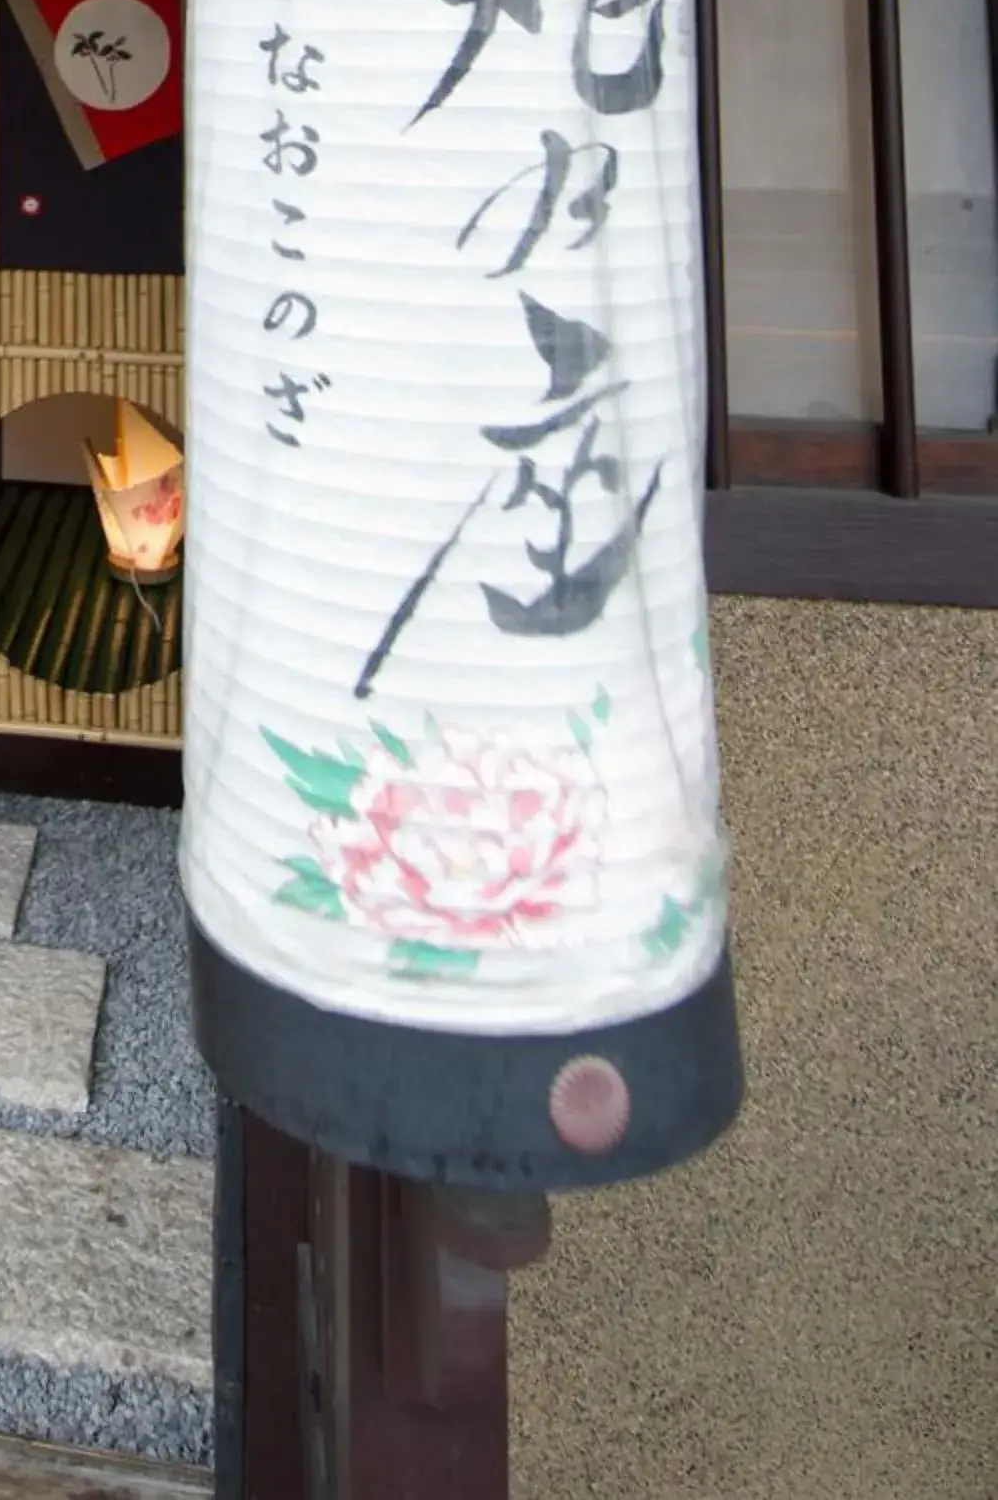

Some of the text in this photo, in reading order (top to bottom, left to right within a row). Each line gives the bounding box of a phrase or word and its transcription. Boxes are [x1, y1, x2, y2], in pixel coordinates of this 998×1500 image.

[259, 23, 332, 449] なおこのざ
